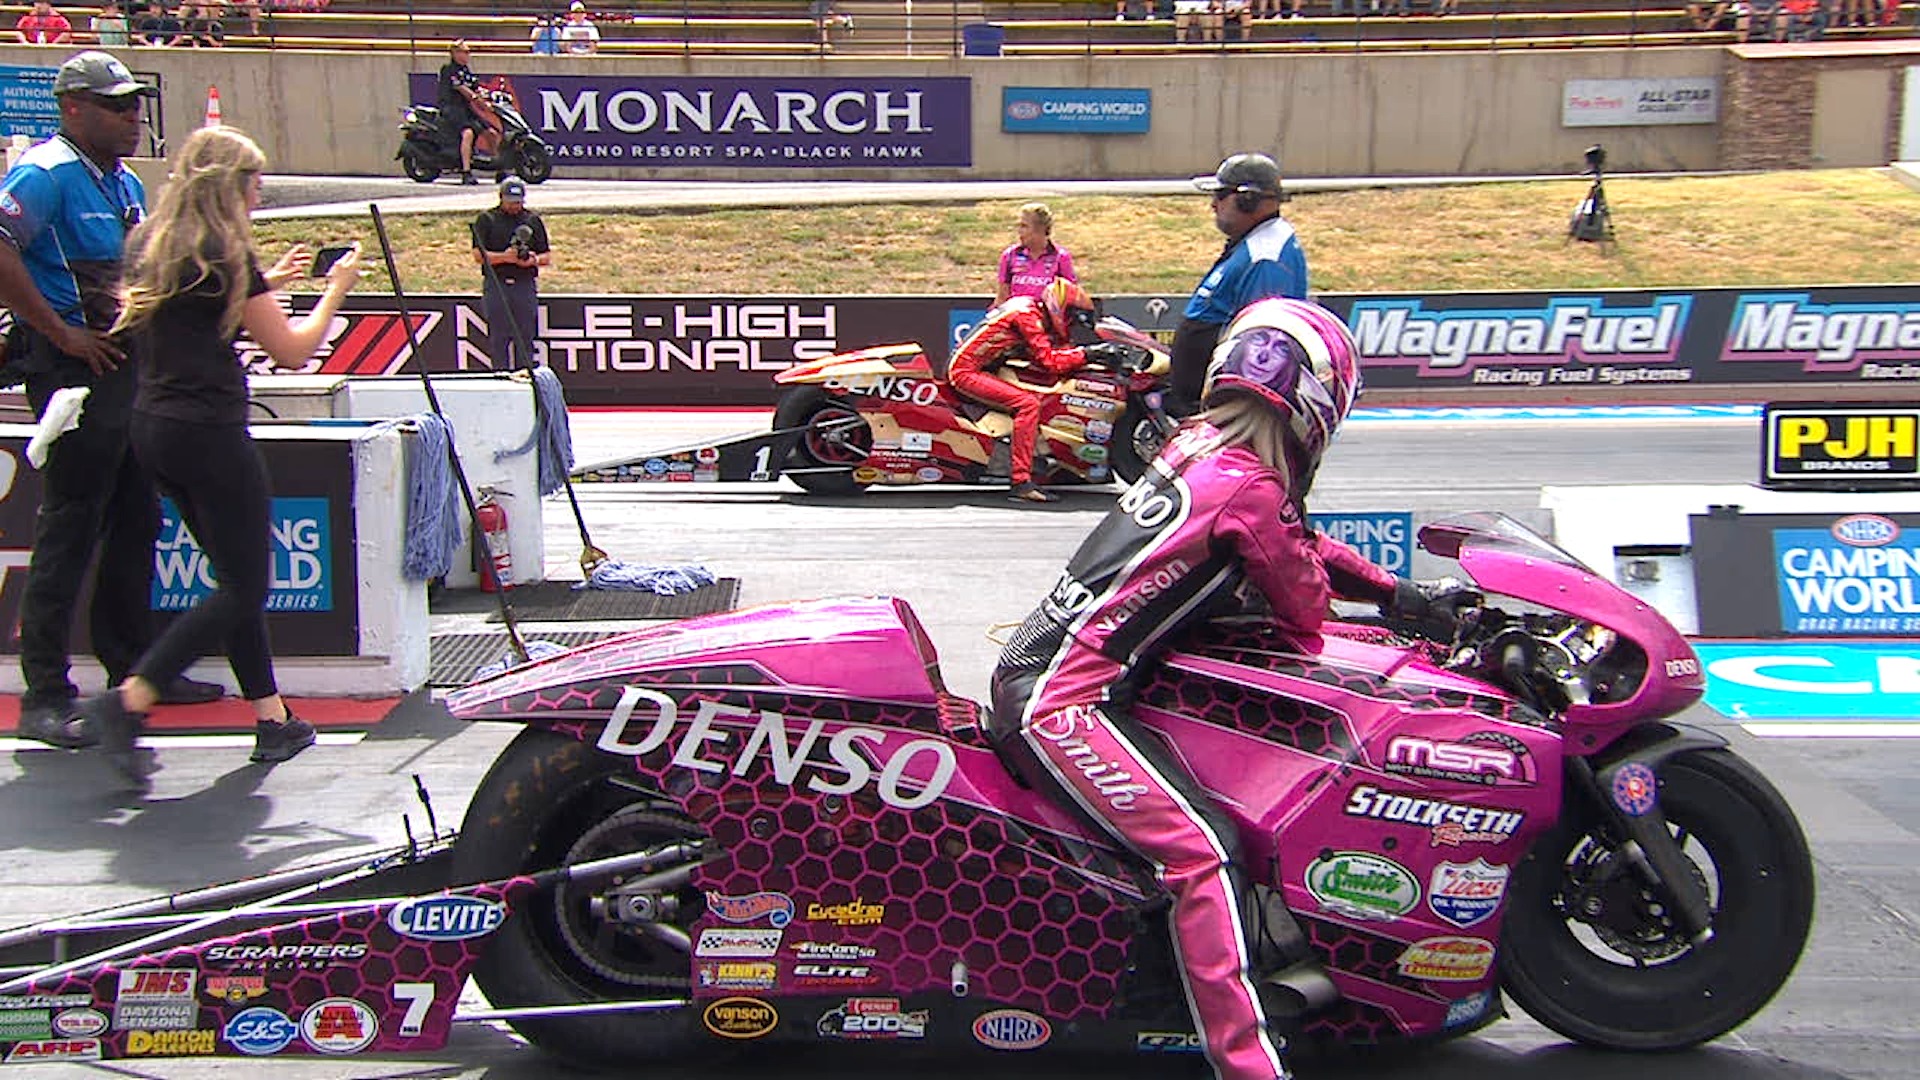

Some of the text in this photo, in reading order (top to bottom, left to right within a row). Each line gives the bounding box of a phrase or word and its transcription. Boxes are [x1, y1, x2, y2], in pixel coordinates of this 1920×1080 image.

[539, 90, 925, 134] MONARCH
[1042, 101, 1146, 116] CAMPING WORLD
[544, 145, 924, 159] CASINO RESORT SPA BLACK HAWK
[457, 303, 836, 339] MLE-HIGH
[1356, 303, 1674, 367] MagnaFuel
[1474, 366, 1692, 386] Racing Fuel Systems
[1779, 416, 1915, 459] PJH
[754, 446, 770, 473] 1
[1801, 460, 1891, 471] BRANDS
[154, 518, 321, 552] CANG
[1314, 519, 1405, 544] MPING
[159, 594, 320, 610] DRAG SERIES
[1093, 558, 1191, 637] vanson
[1796, 617, 1838, 631] DRAG
[1841, 617, 1899, 631] RACING
[596, 685, 958, 810] DENSO
[1030, 704, 1149, 813] Smith
[1388, 736, 1515, 777] MSR
[1345, 785, 1523, 834] STOCKSETH
[394, 904, 499, 933] CLEVITE
[206, 944, 369, 960] SCRAPPERS
[242, 960, 326, 970] RACING
[793, 964, 870, 978] ELITE
[121, 971, 191, 995] JMS
[119, 1005, 192, 1017] DAYTONA
[394, 983, 435, 1037] 7
[714, 1006, 770, 1020] vanson
[118, 1017, 190, 1028] SENSORS
[235, 1019, 288, 1041] S&S
[985, 1019, 1039, 1043] NHRA
[14, 1042, 97, 1056] ARP
